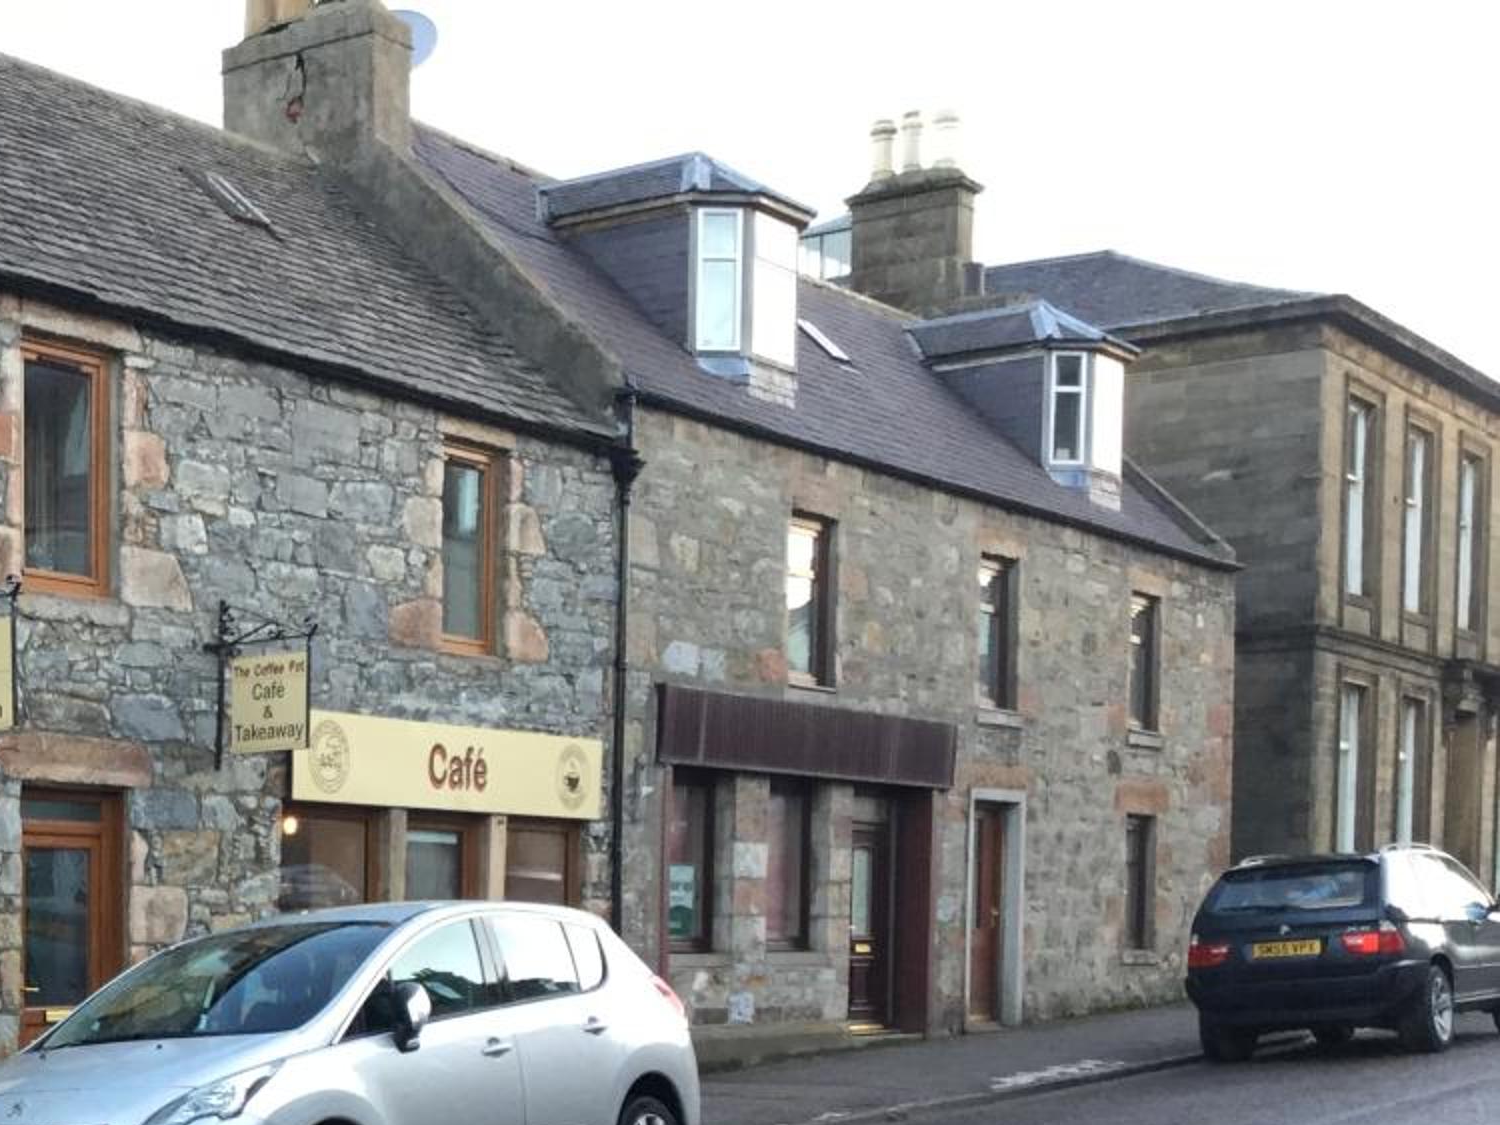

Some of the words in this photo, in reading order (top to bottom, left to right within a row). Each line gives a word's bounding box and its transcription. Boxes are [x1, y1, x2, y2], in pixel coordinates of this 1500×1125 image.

[253, 661, 285, 677] Coffee
[262, 704, 273, 719] &
[235, 721, 304, 741] Takeaway
[427, 743, 488, 794] Café
